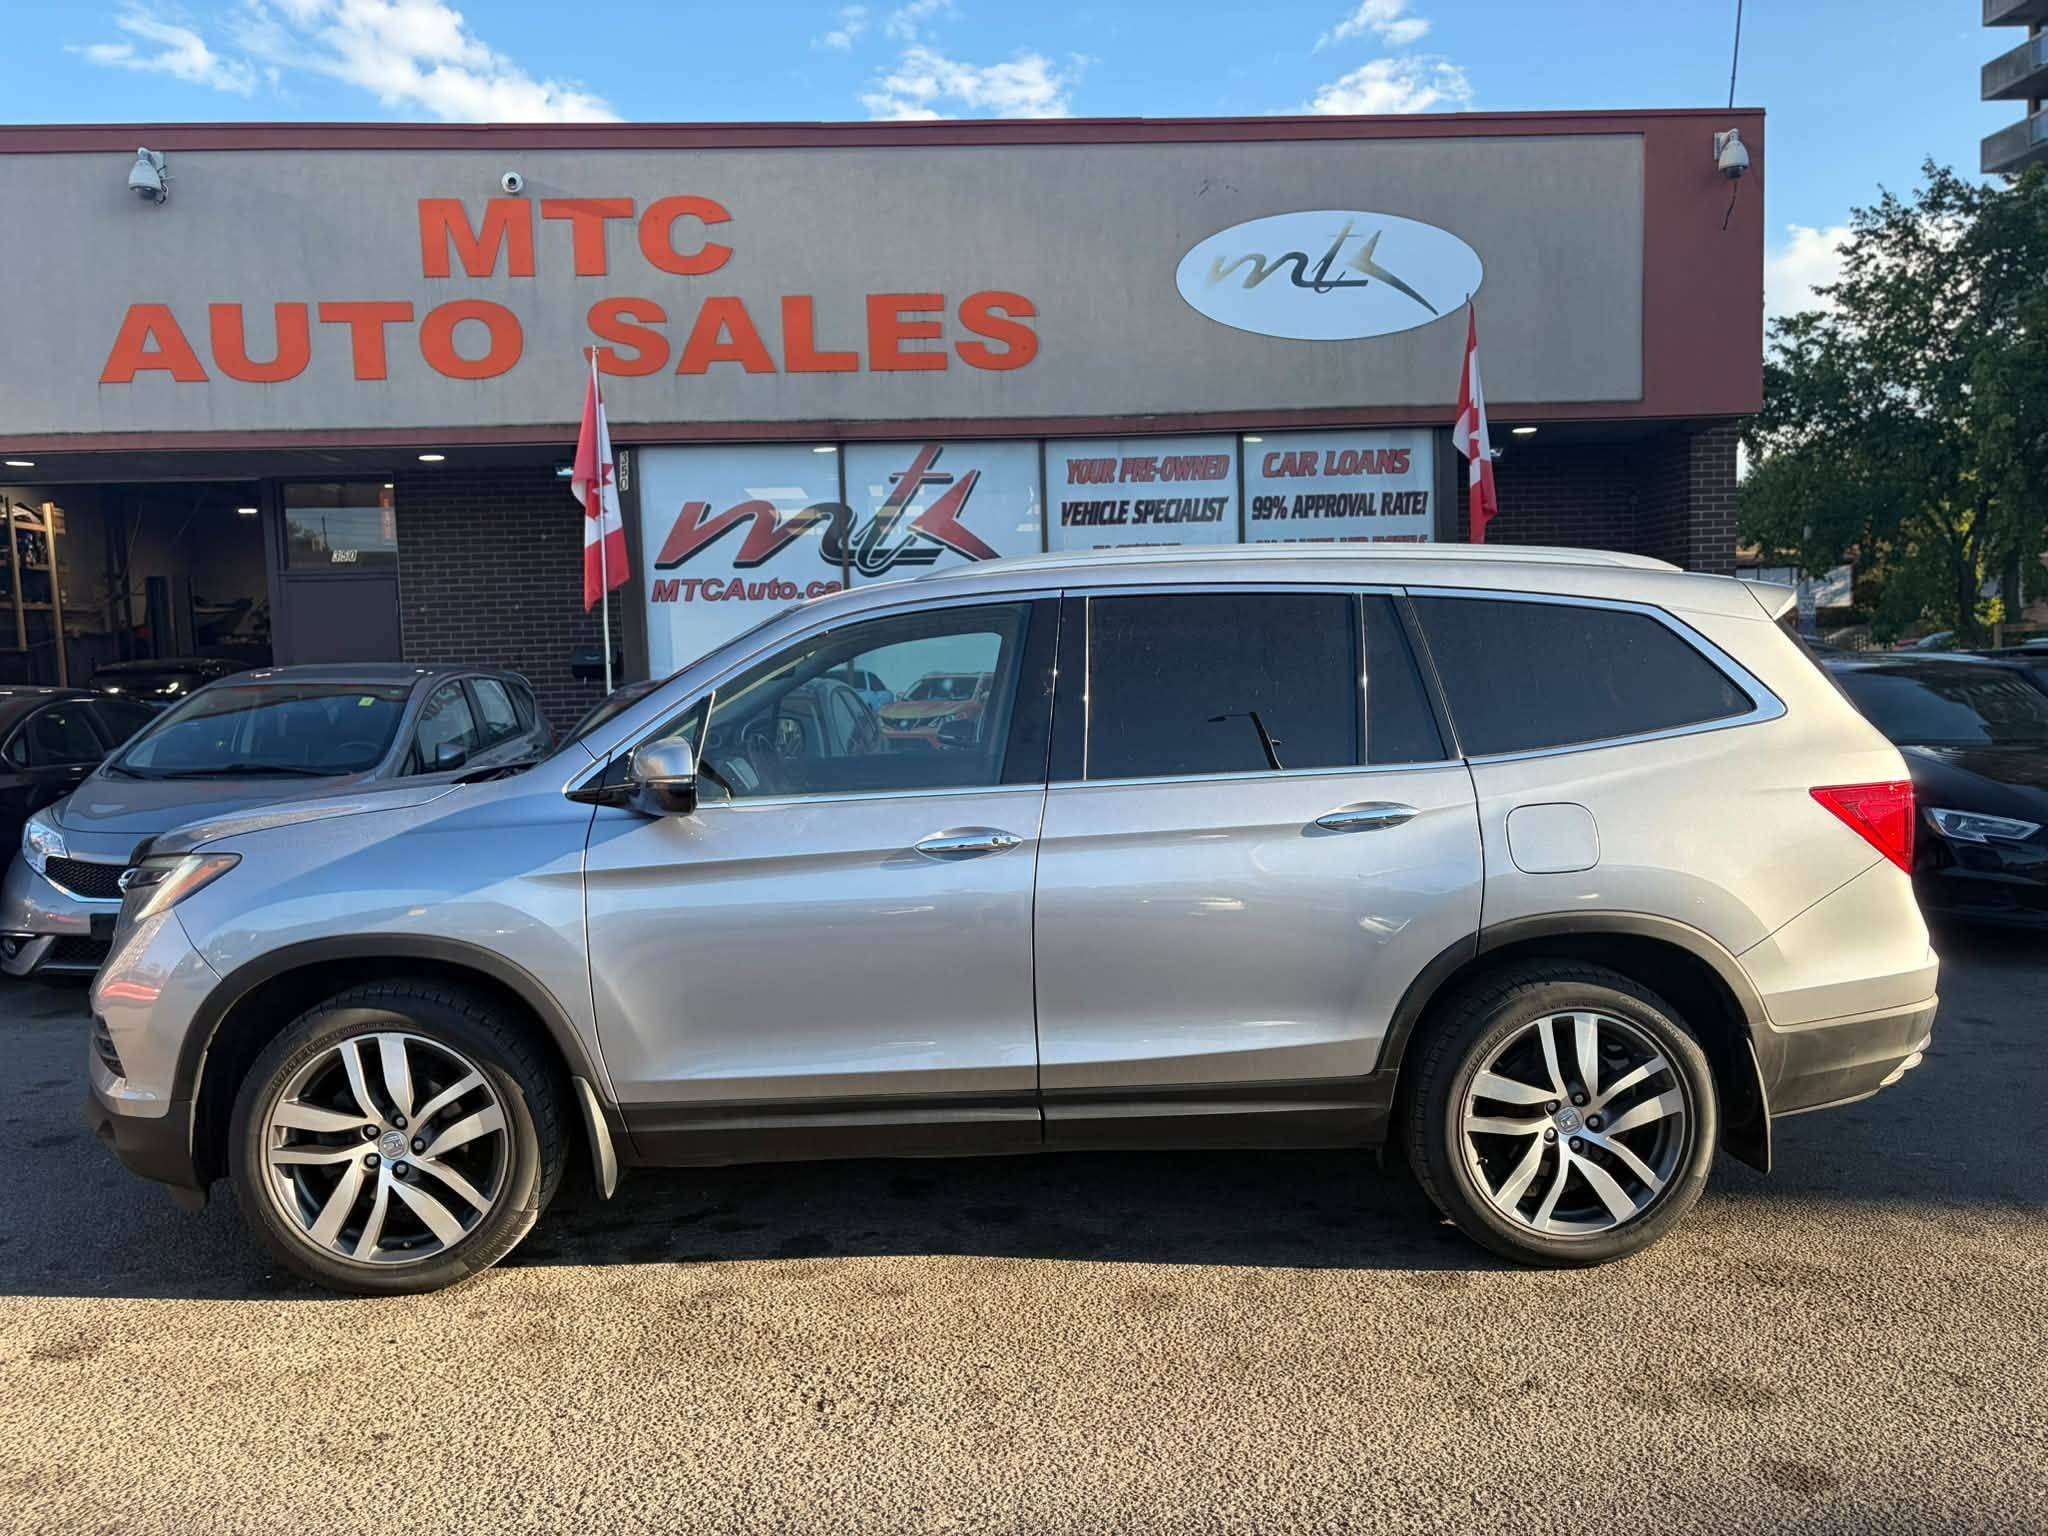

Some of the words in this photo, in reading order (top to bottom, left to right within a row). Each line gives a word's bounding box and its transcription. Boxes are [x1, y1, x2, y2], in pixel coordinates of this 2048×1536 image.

[417, 195, 734, 278] MTC
[98, 299, 525, 384] AUTO
[583, 290, 1040, 377] SALES
[1066, 457, 1117, 485] YOUR
[1119, 454, 1231, 483] PRE-OWNED
[1262, 450, 1319, 478] CAR
[1323, 448, 1411, 477] LOANS
[1061, 499, 1131, 527] VEHICLE
[1131, 496, 1230, 525] SPECIALIST
[1252, 495, 1288, 521] 99%
[1291, 492, 1377, 520] APPROVAL
[1380, 490, 1428, 516] RATE!
[652, 576, 843, 603] MTCAuto.ca
